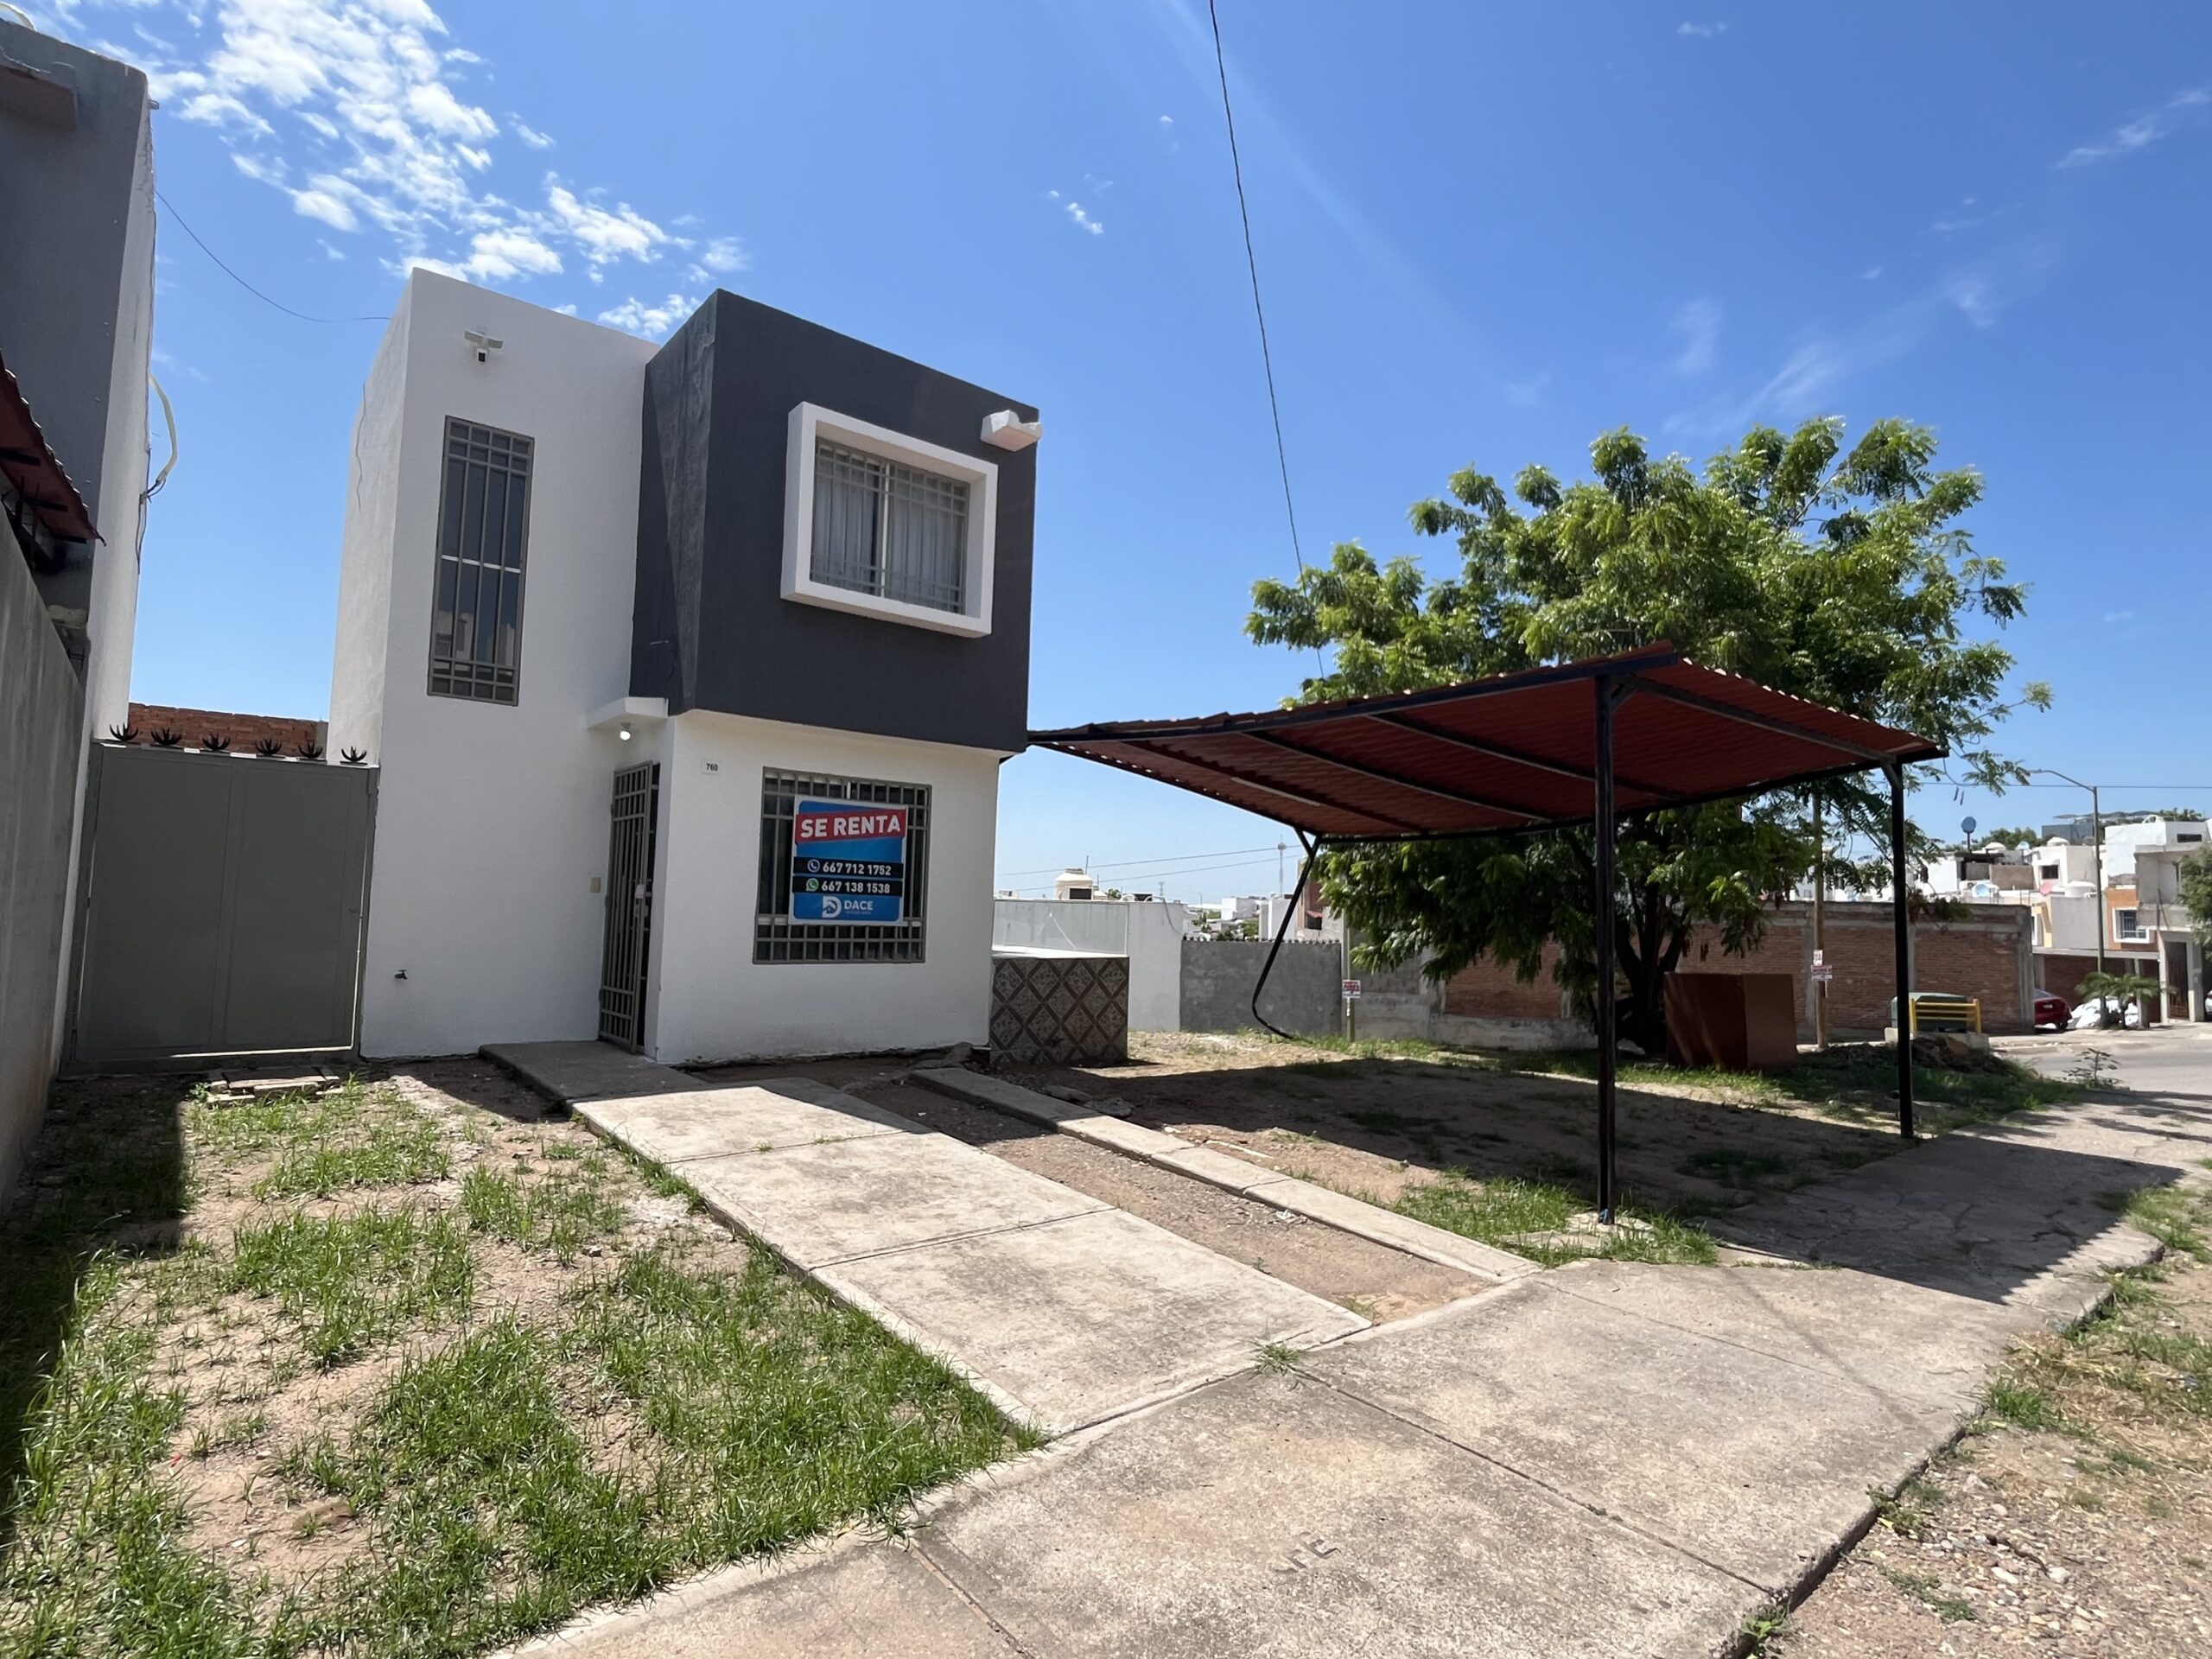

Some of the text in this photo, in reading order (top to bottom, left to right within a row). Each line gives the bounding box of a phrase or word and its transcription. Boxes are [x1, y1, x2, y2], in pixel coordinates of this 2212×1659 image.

[800, 815, 900, 838] SE RENTA
[823, 861, 892, 876] 667 712 1752
[822, 880, 891, 894] 667 138 1538
[844, 899, 874, 911] DACE
